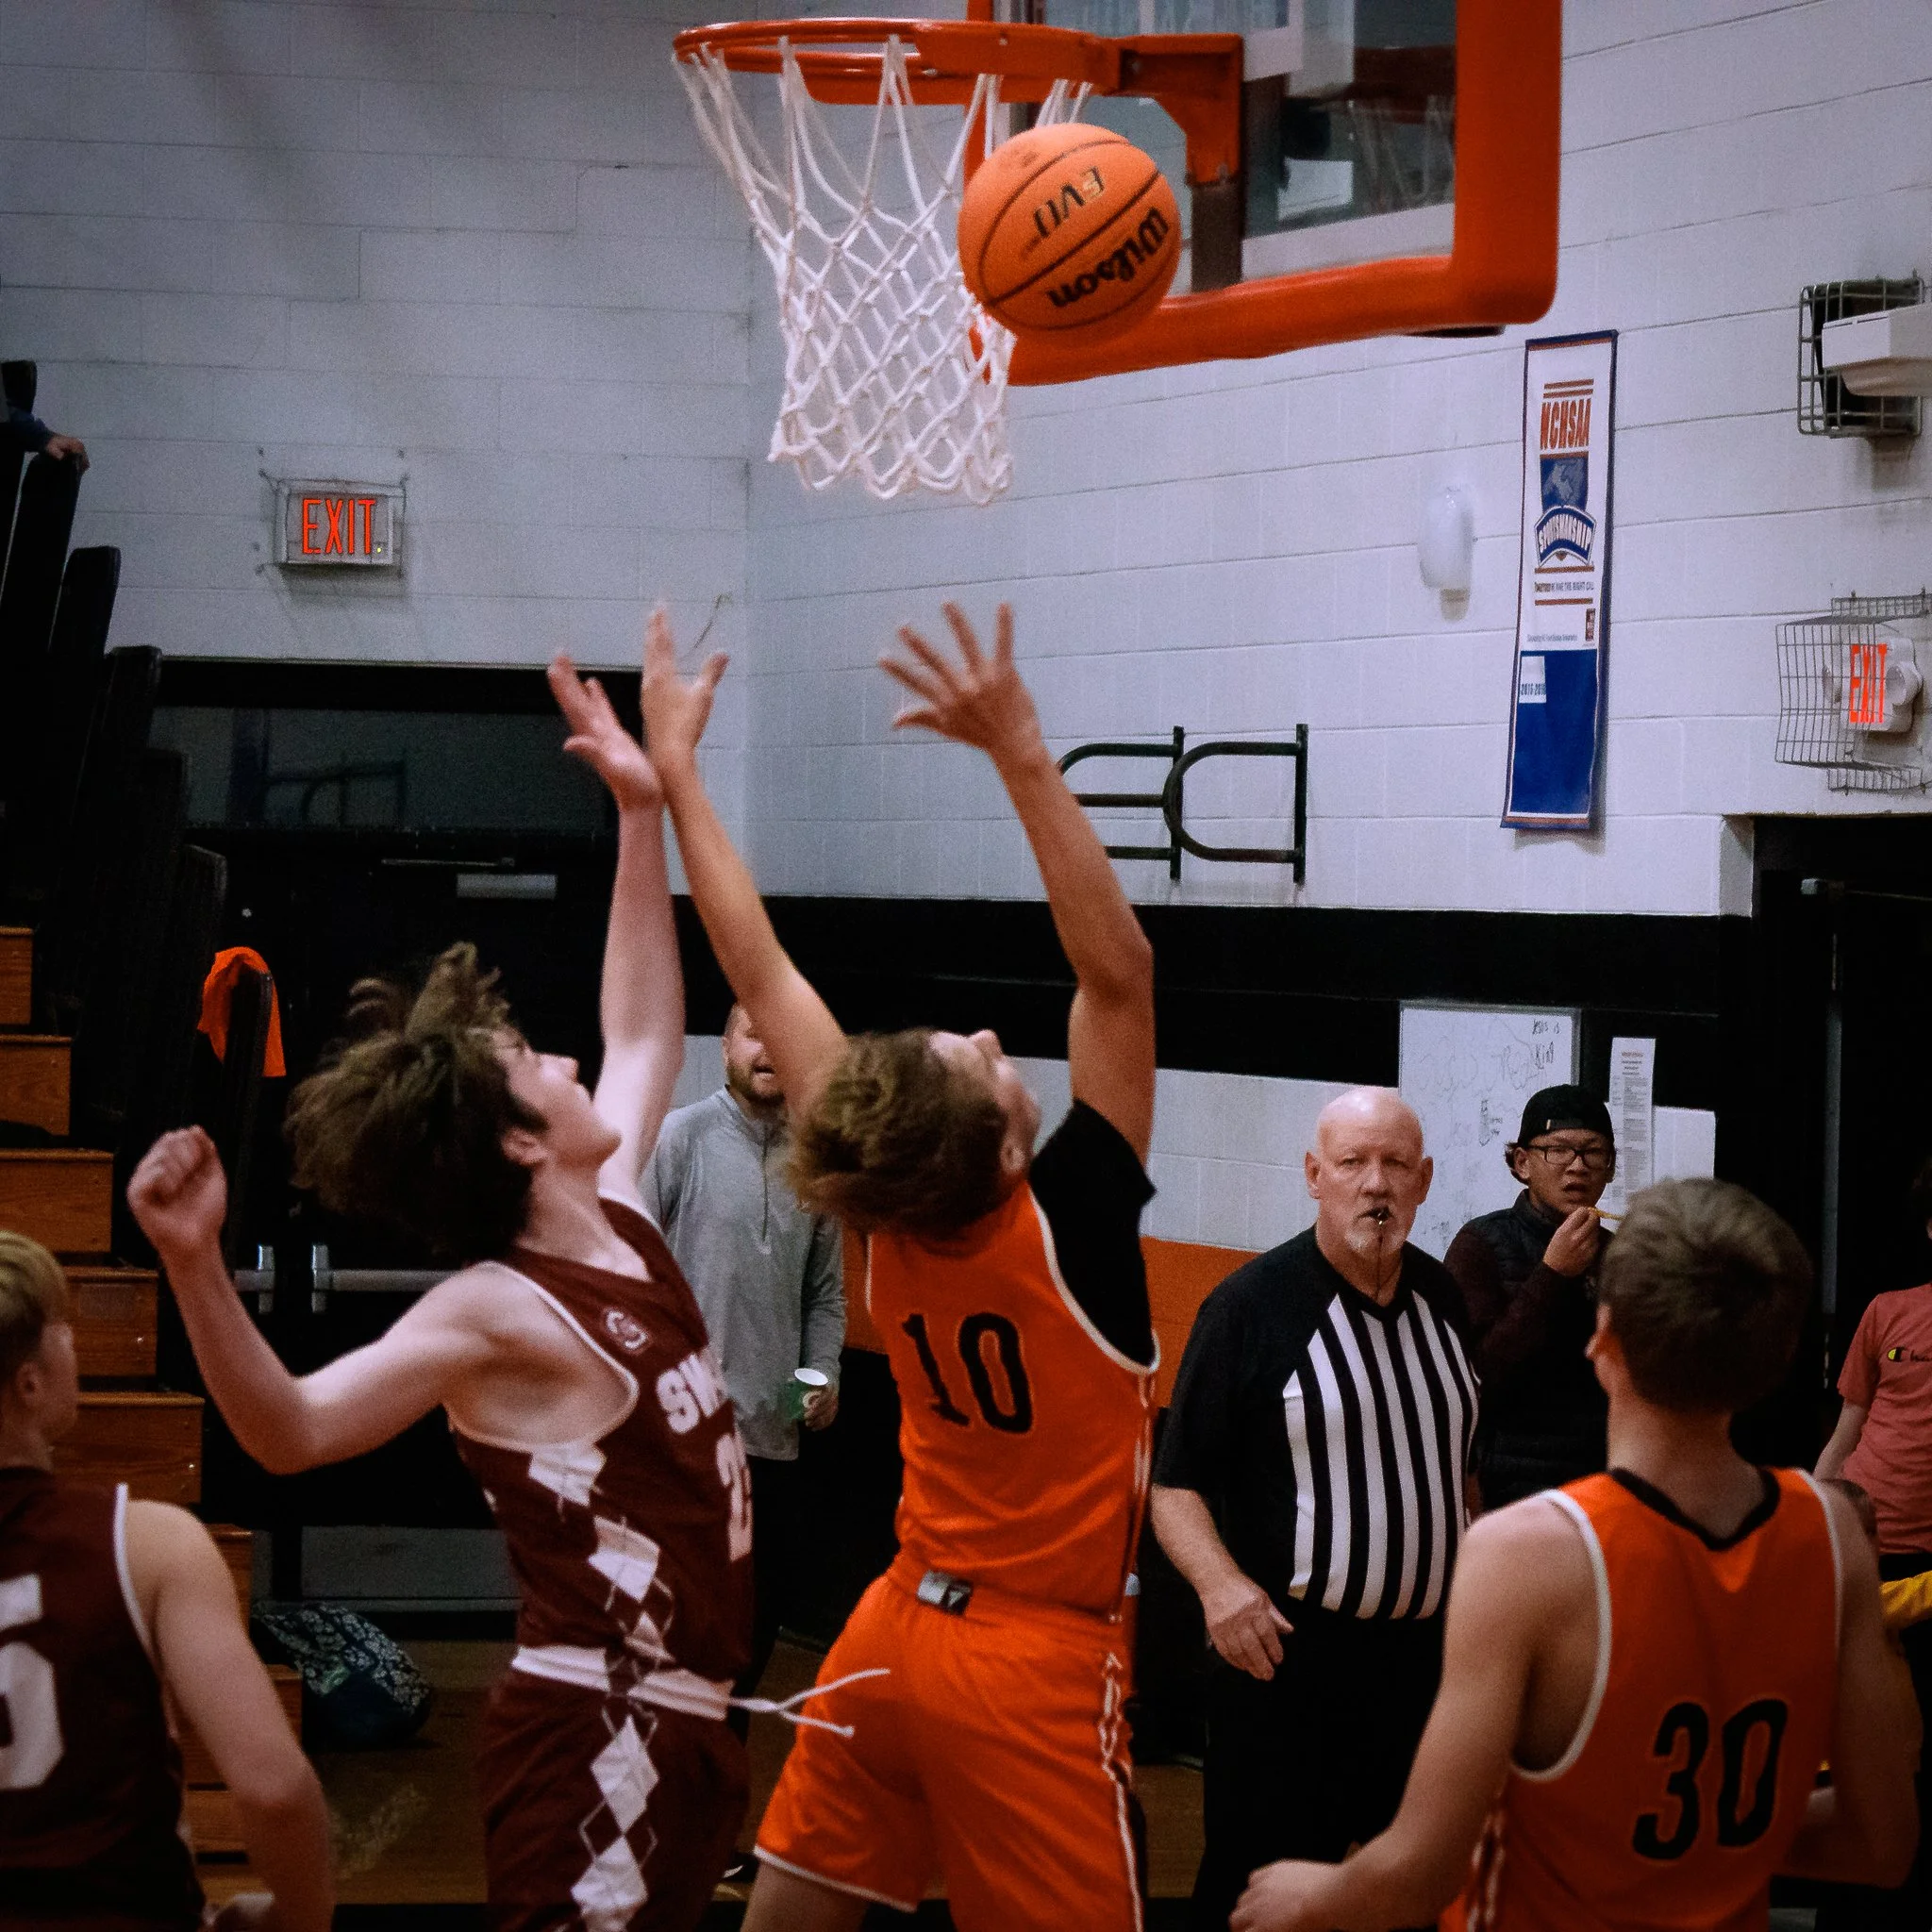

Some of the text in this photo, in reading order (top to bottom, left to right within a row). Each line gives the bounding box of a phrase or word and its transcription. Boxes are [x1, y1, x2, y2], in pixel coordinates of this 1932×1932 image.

[1045, 207, 1170, 308] Wilson
[302, 498, 376, 555] EXIT
[1849, 643, 1887, 724] EXIT
[902, 1311, 1034, 1434] 10
[1632, 1699, 1789, 1861] 30
